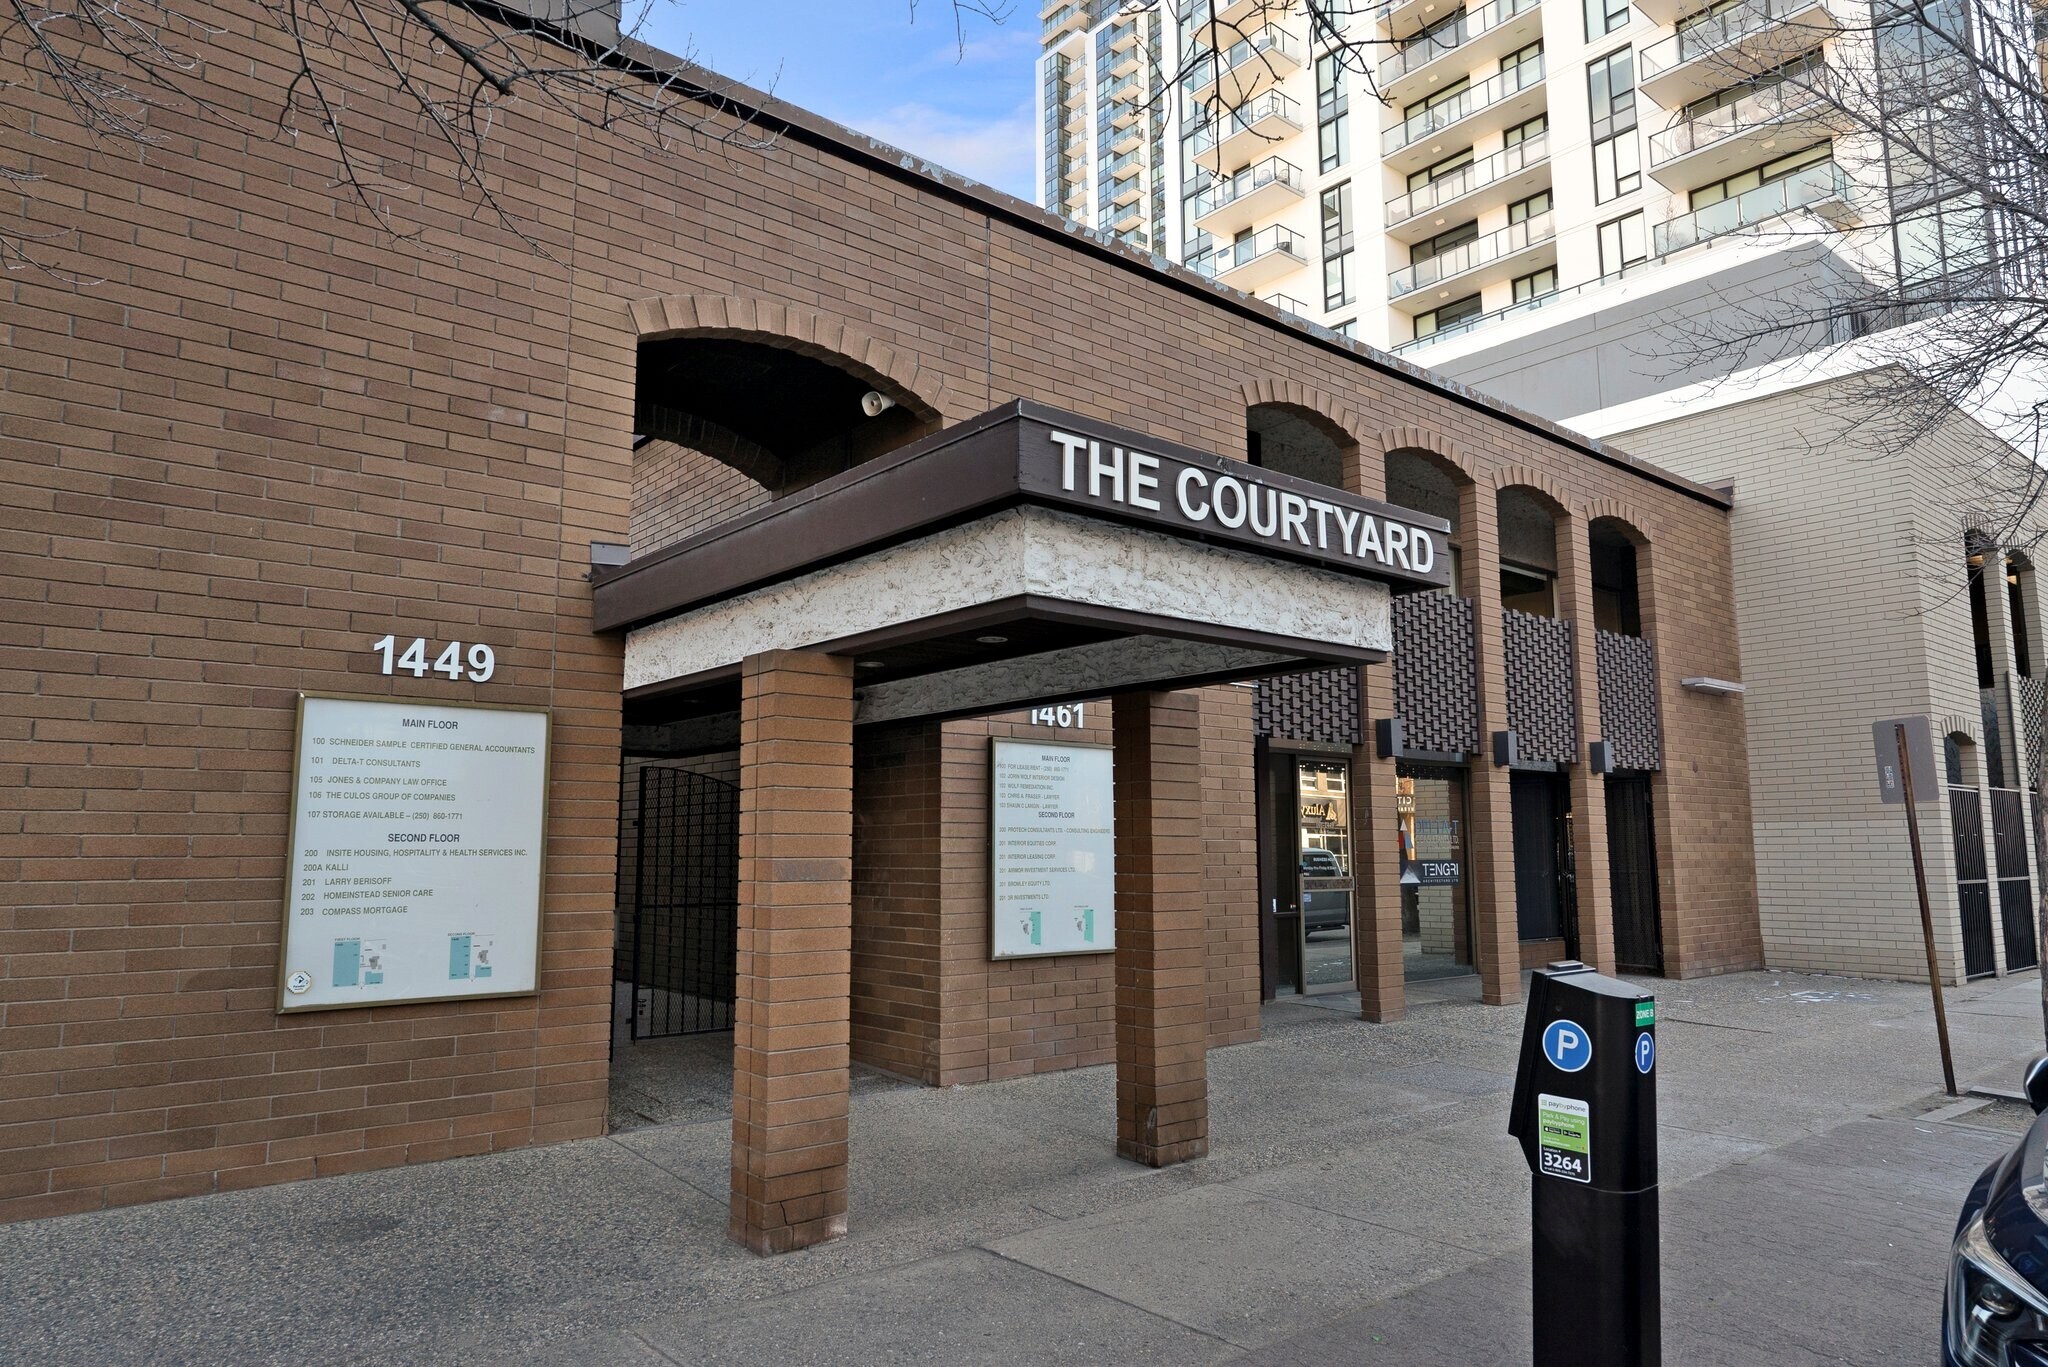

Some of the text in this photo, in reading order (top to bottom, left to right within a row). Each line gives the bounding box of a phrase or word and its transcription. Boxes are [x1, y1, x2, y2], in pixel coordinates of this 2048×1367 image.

[1050, 430, 1434, 574] THE COURTYARD
[373, 634, 495, 682] 1449
[1031, 702, 1084, 728] 1461
[402, 718, 458, 730] MAIN FLOOR
[329, 738, 374, 747] SCHNEIDER
[376, 740, 407, 749] SAMPLE
[410, 742, 448, 750] CERTIFIED
[450, 743, 483, 751] GENERAL
[485, 745, 535, 754] ACCOUNTANTS
[332, 757, 364, 766] DELTA-T
[366, 758, 421, 768] CONSULTANTS
[363, 777, 402, 785] COMPANY
[402, 778, 419, 786] LAW
[420, 778, 447, 787] OFFICE
[373, 792, 400, 800] GROUP
[413, 793, 456, 802] COMPANIES
[322, 811, 361, 819] STORAGE
[363, 811, 404, 819] AVAILABLE
[412, 812, 430, 821] (250)
[432, 812, 463, 820] 860-1771
[388, 833, 460, 843] SECOND FLOOR
[393, 849, 441, 857] HOSPITALITY
[449, 849, 477, 857] HEALTH
[478, 848, 513, 856] SERVICES
[514, 848, 528, 856] INC.
[303, 864, 323, 872] 200A
[1422, 863, 1459, 876] TENGRI
[325, 877, 352, 886] LARRY
[353, 877, 392, 885] BERISOFF
[323, 891, 380, 900] HOMEINSTEAD
[382, 890, 411, 898] SENIOR
[413, 889, 434, 897] CARE
[300, 906, 408, 916] 203 COMPASS MORTGAGE
[1636, 1010, 1649, 1019] ZONE
[1557, 1029, 1578, 1060] P
[1641, 1040, 1650, 1065] P
[1548, 1102, 1586, 1113] paybyphone
[1544, 1153, 1582, 1173] 3264
